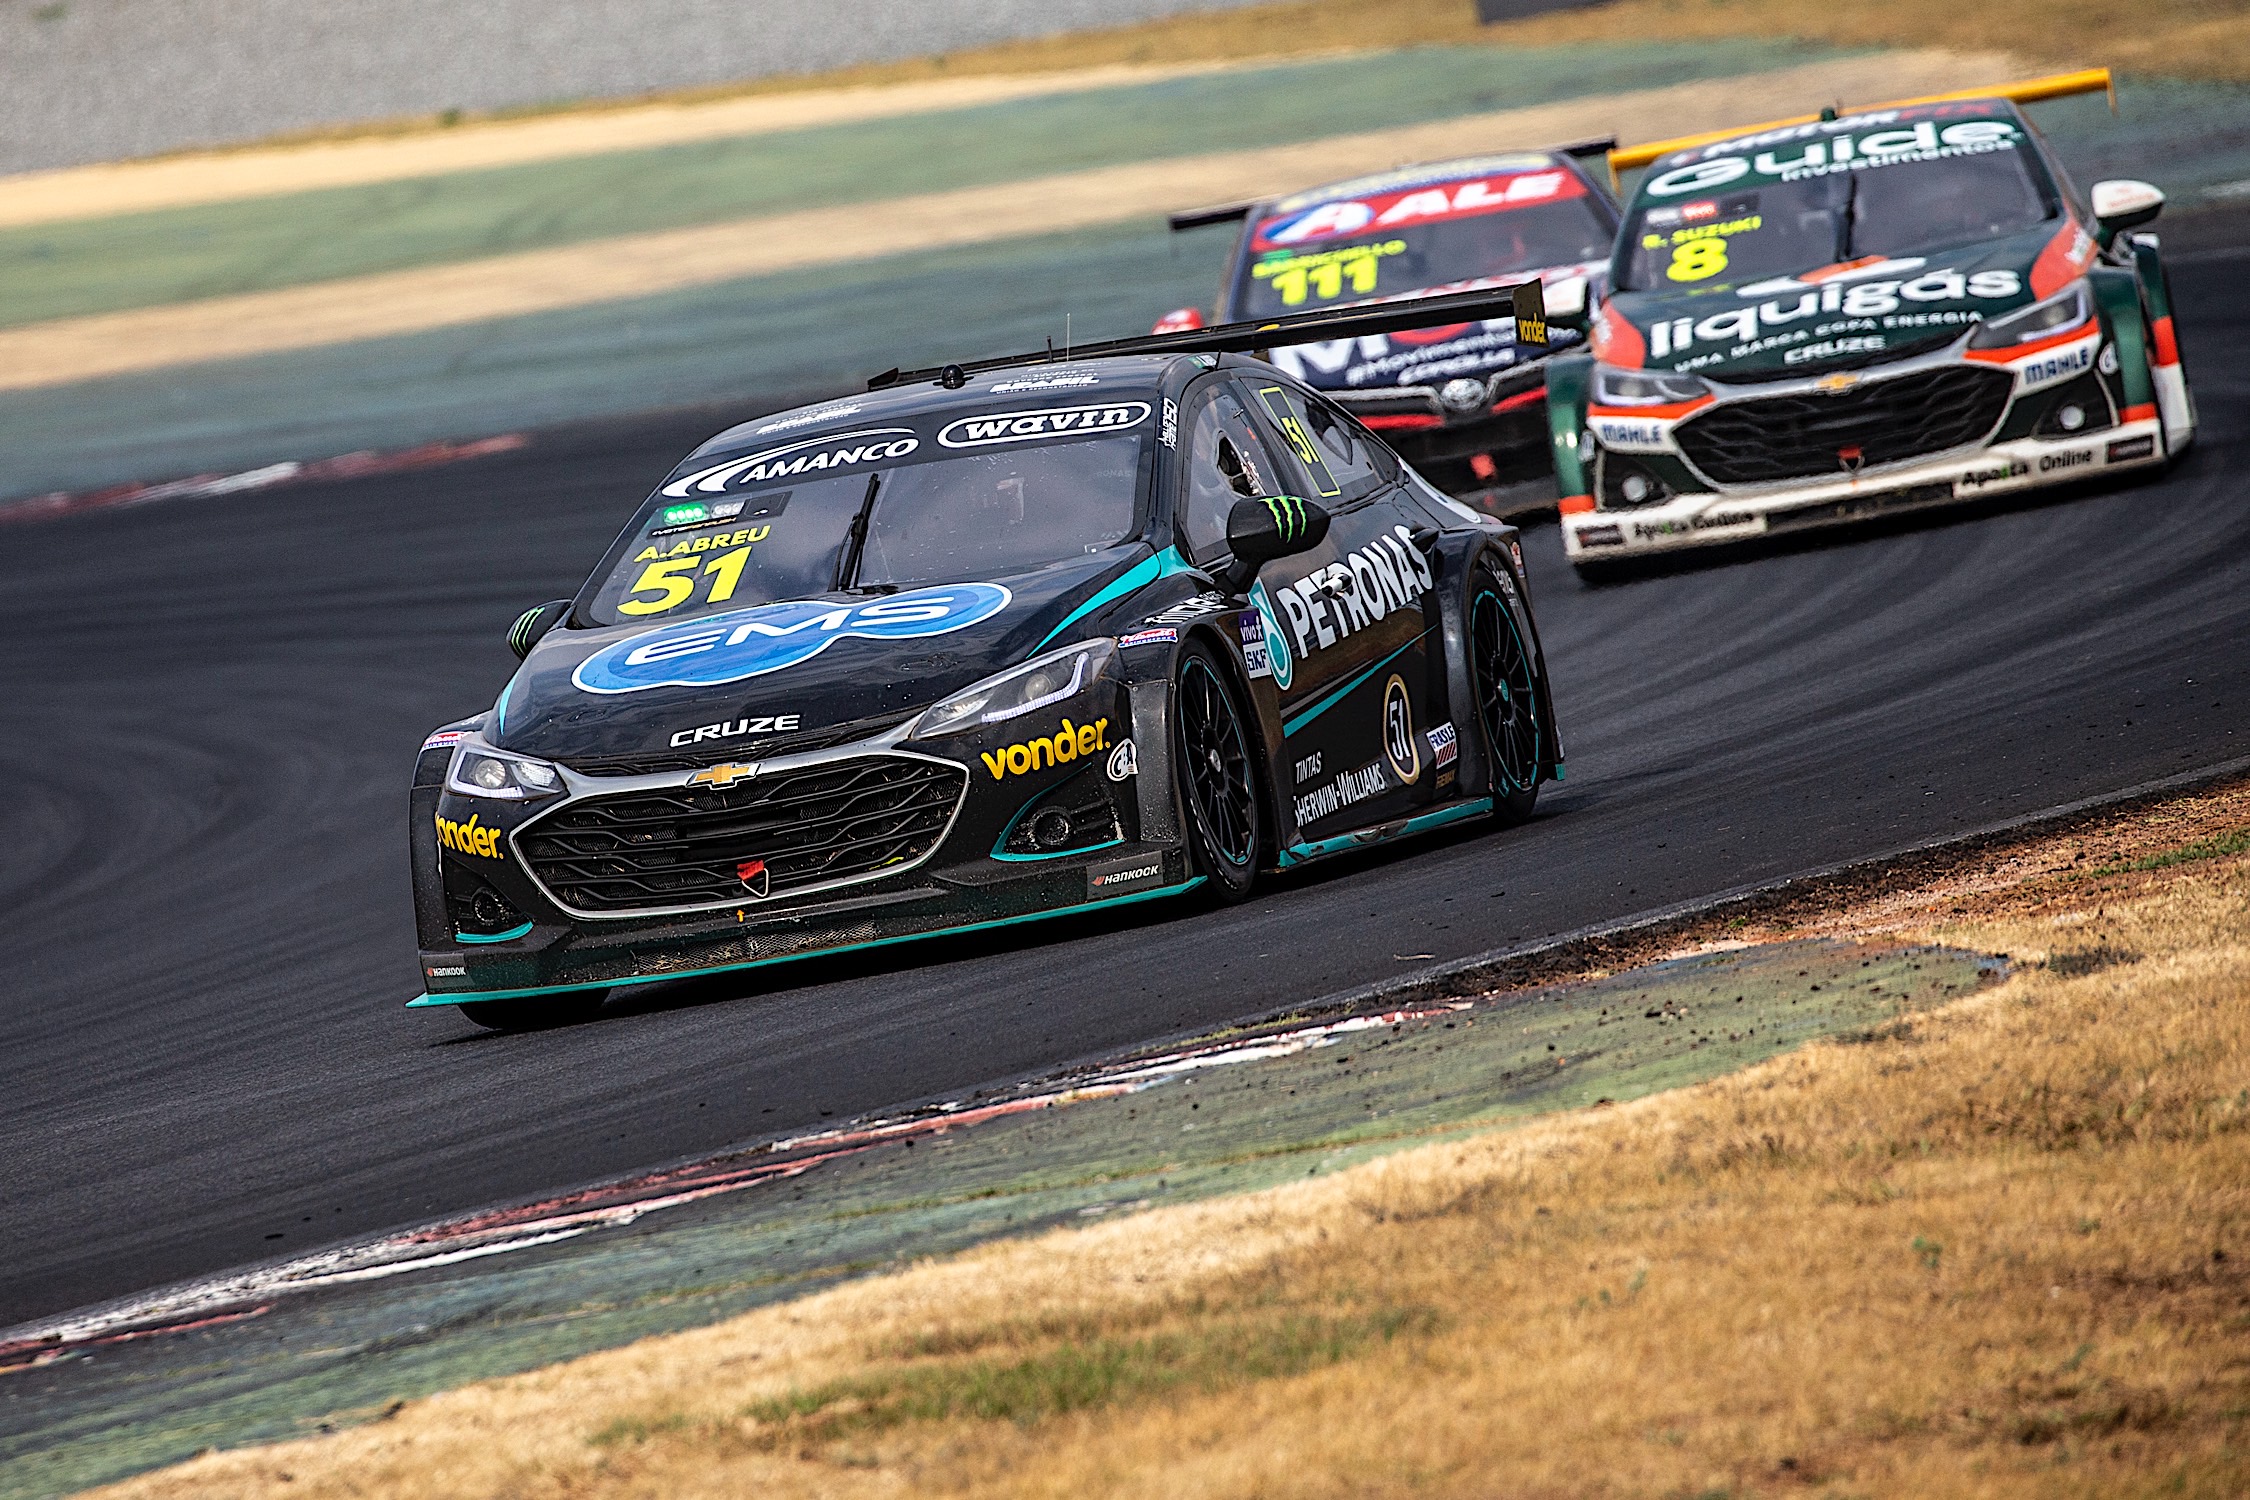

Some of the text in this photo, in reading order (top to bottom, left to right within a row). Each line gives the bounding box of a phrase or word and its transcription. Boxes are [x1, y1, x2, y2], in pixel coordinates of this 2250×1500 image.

[1646, 121, 2014, 196] Guide
[1375, 171, 1566, 226] ALE
[1671, 215, 1762, 245] SUZUKI
[1272, 253, 1378, 305] 111
[1666, 237, 1728, 282] 8
[1650, 268, 2021, 358] liquigás
[1674, 310, 1984, 373] UMA MARCA COPA ENERGIA
[1784, 334, 1886, 364] CRUZE
[2025, 347, 2088, 384] MAHLE
[964, 406, 1130, 436] wavin
[1281, 416, 1319, 465] 51
[1602, 424, 1662, 443] MAHLE
[739, 438, 919, 484] AMANCO
[2039, 450, 2092, 473] Online
[634, 525, 771, 562] A.ABREU
[617, 546, 752, 616] 51
[1275, 525, 1433, 660] PETRONAS
[625, 596, 955, 665] EMS
[1247, 650, 1267, 672] SKF
[669, 715, 800, 748] CRUZE
[1389, 698, 1411, 761] 51
[1295, 751, 1322, 784] TINTAS
